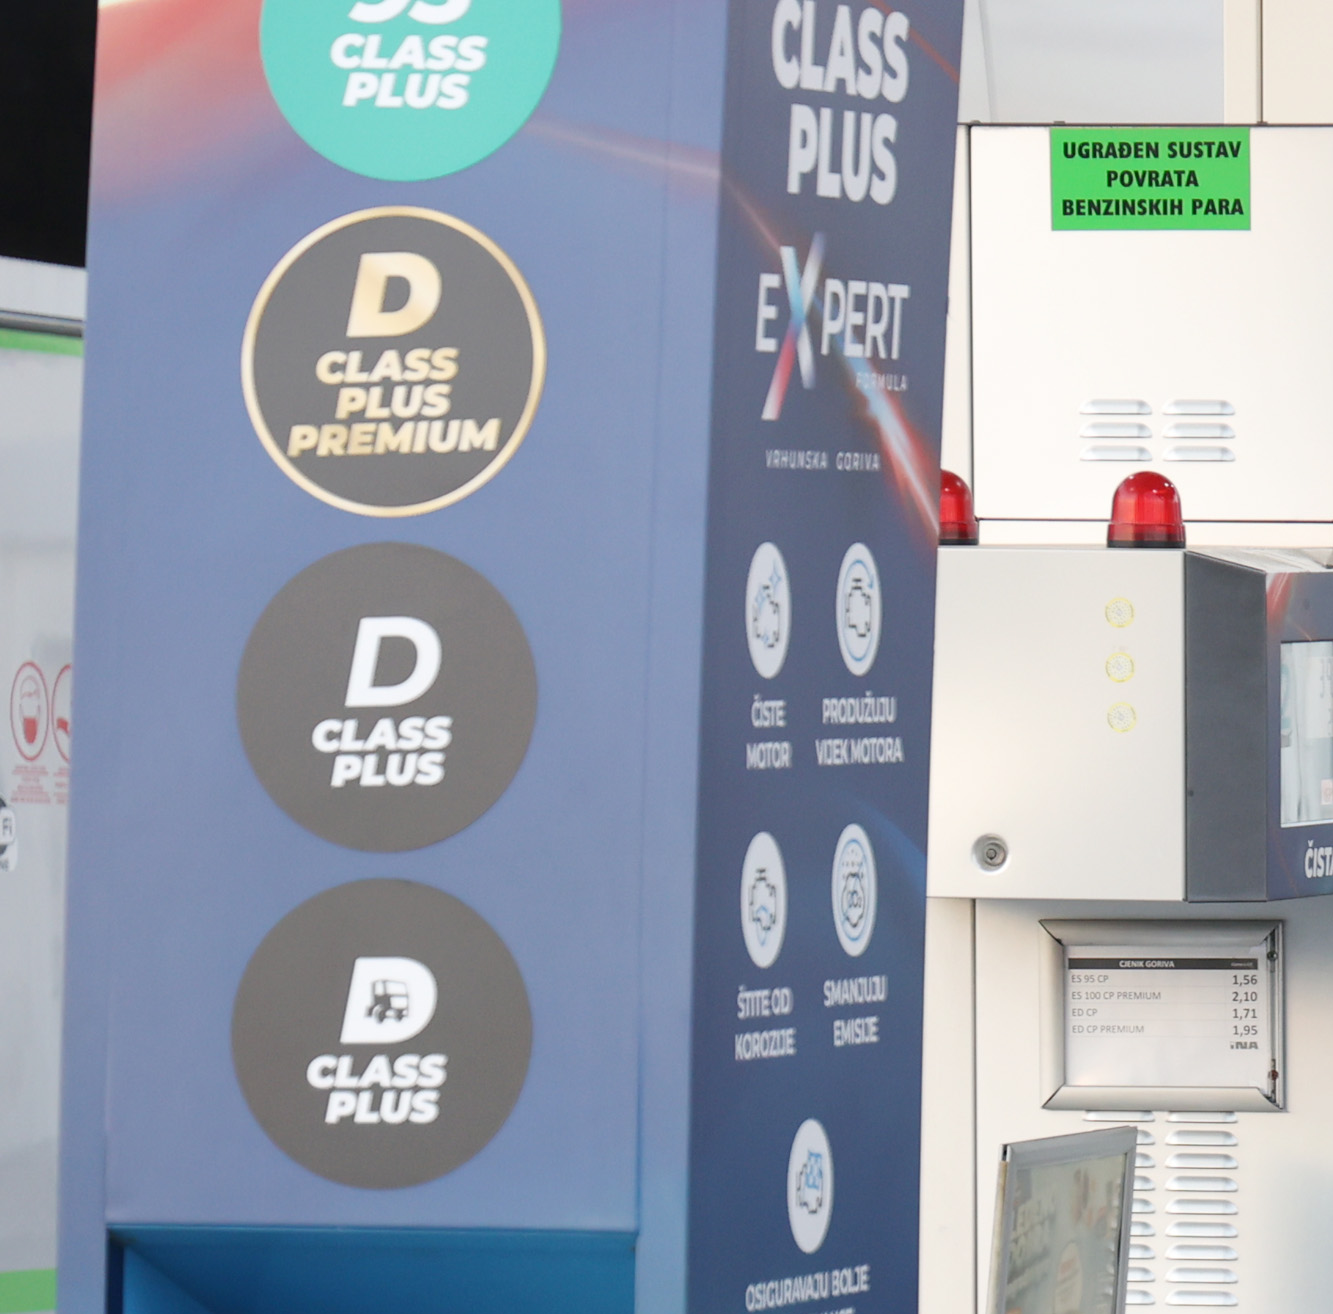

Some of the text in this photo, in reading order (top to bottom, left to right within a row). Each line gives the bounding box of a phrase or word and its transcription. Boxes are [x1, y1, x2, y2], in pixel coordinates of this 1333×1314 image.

[330, 33, 489, 72] CLASS
[771, 0, 910, 103] CLASS
[342, 71, 471, 110] PLUS
[787, 103, 898, 205] PLUS
[1063, 141, 1242, 158] UGRAĐEN SUSTAV
[1106, 170, 1199, 187] POVRATA
[1062, 198, 1244, 216] BENZINSKIH PARA
[345, 251, 442, 338] D
[755, 231, 910, 421] EXPERT
[315, 347, 459, 385] CLASS
[855, 372, 908, 391] FORMULA
[334, 383, 451, 420] PLUS
[287, 417, 500, 458] PREMIUM
[765, 449, 881, 471] VRHUNSKA GORIVA
[344, 616, 442, 707] D
[751, 693, 787, 728] ČISTE
[822, 690, 898, 724] PRODUŽUJU
[311, 716, 452, 753] CLASS
[815, 736, 905, 766] VIJEK MOTORA
[331, 752, 445, 787] PLUS
[746, 740, 793, 770] MOTOR
[1071, 974, 1258, 986] ES 95 CP 1,56
[1145, 960, 1175, 968] GORIVA
[340, 956, 438, 1044] D
[737, 984, 794, 1020] ŠTITE OD
[823, 974, 888, 1007] SMANJUJU
[1071, 991, 1258, 1003] ES 100 CP PREMIUM 2,10
[833, 1016, 880, 1047] EMISIJE
[1072, 1008, 1257, 1020] ED CP 1,71
[1072, 1025, 1258, 1037] ED CP PREMIUM 1,95
[735, 1027, 797, 1061] KOROZIJE
[306, 1053, 448, 1090] CLASS
[325, 1089, 440, 1125] PLUS
[745, 1263, 871, 1312] OSIGURAVAJU BOLJE
